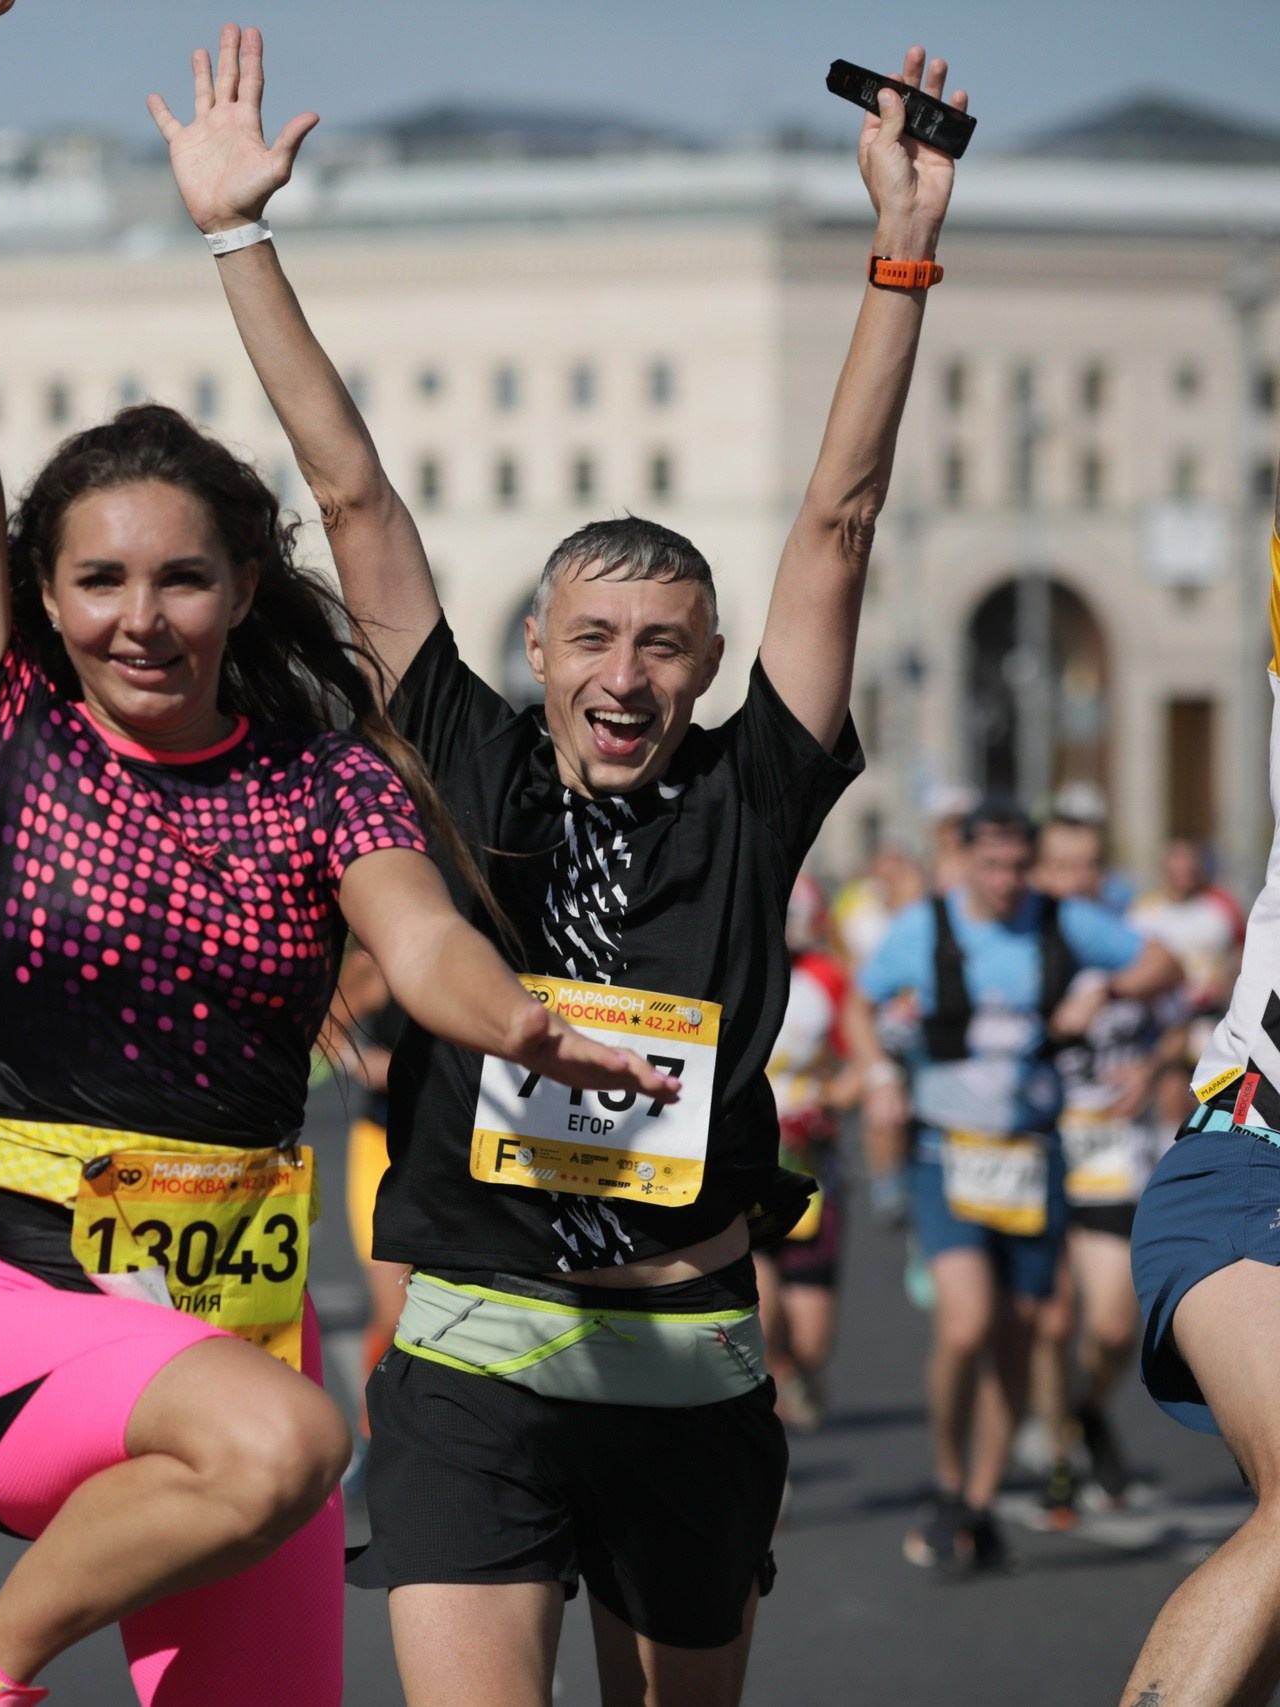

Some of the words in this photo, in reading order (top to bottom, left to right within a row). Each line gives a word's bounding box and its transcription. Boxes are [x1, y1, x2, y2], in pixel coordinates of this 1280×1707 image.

[558, 987, 645, 1012] МАРАФОН
[556, 1002, 628, 1025] МОСКВА
[645, 1016, 675, 1032] 42,2
[1200, 1067, 1240, 1098] МАРАФОН
[1238, 1081, 1254, 1116] МОСКВА
[568, 1114, 615, 1136] ЕГОР
[495, 1138, 521, 1173] F
[152, 1162, 243, 1177] МАРАФОН
[151, 1178, 226, 1195] МОСКВА
[598, 1178, 631, 1189] СИБУР
[88, 1213, 299, 1287] 13043
[170, 1293, 221, 1313] ЛИЯ
